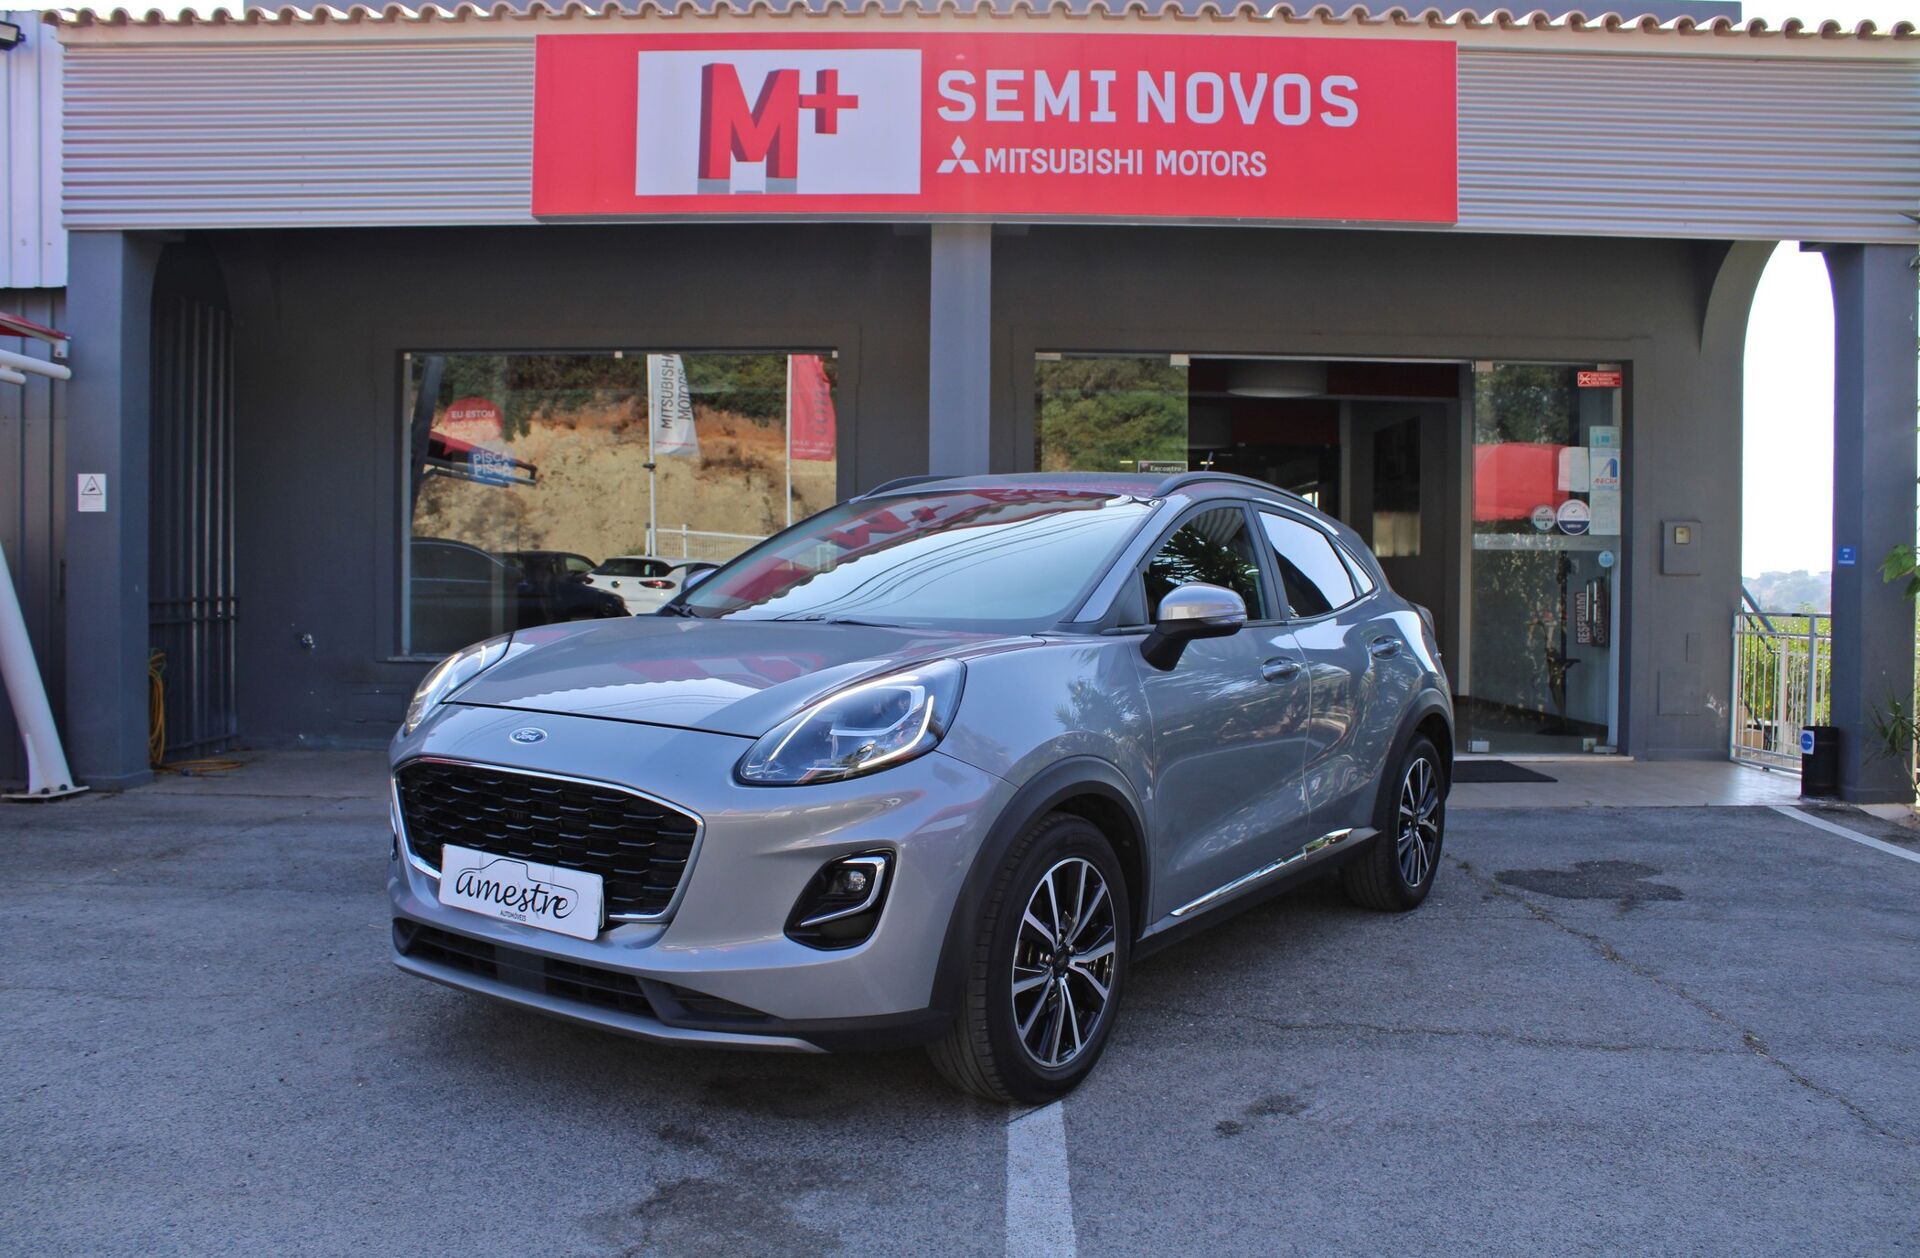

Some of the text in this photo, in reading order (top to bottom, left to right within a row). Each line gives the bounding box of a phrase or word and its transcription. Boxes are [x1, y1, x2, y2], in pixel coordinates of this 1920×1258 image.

[937, 69, 1359, 128] SEMI NOVOS
[984, 147, 1268, 177] MITSUBISHI MOTORS
[451, 410, 464, 419] EU
[456, 870, 569, 920] amestre
